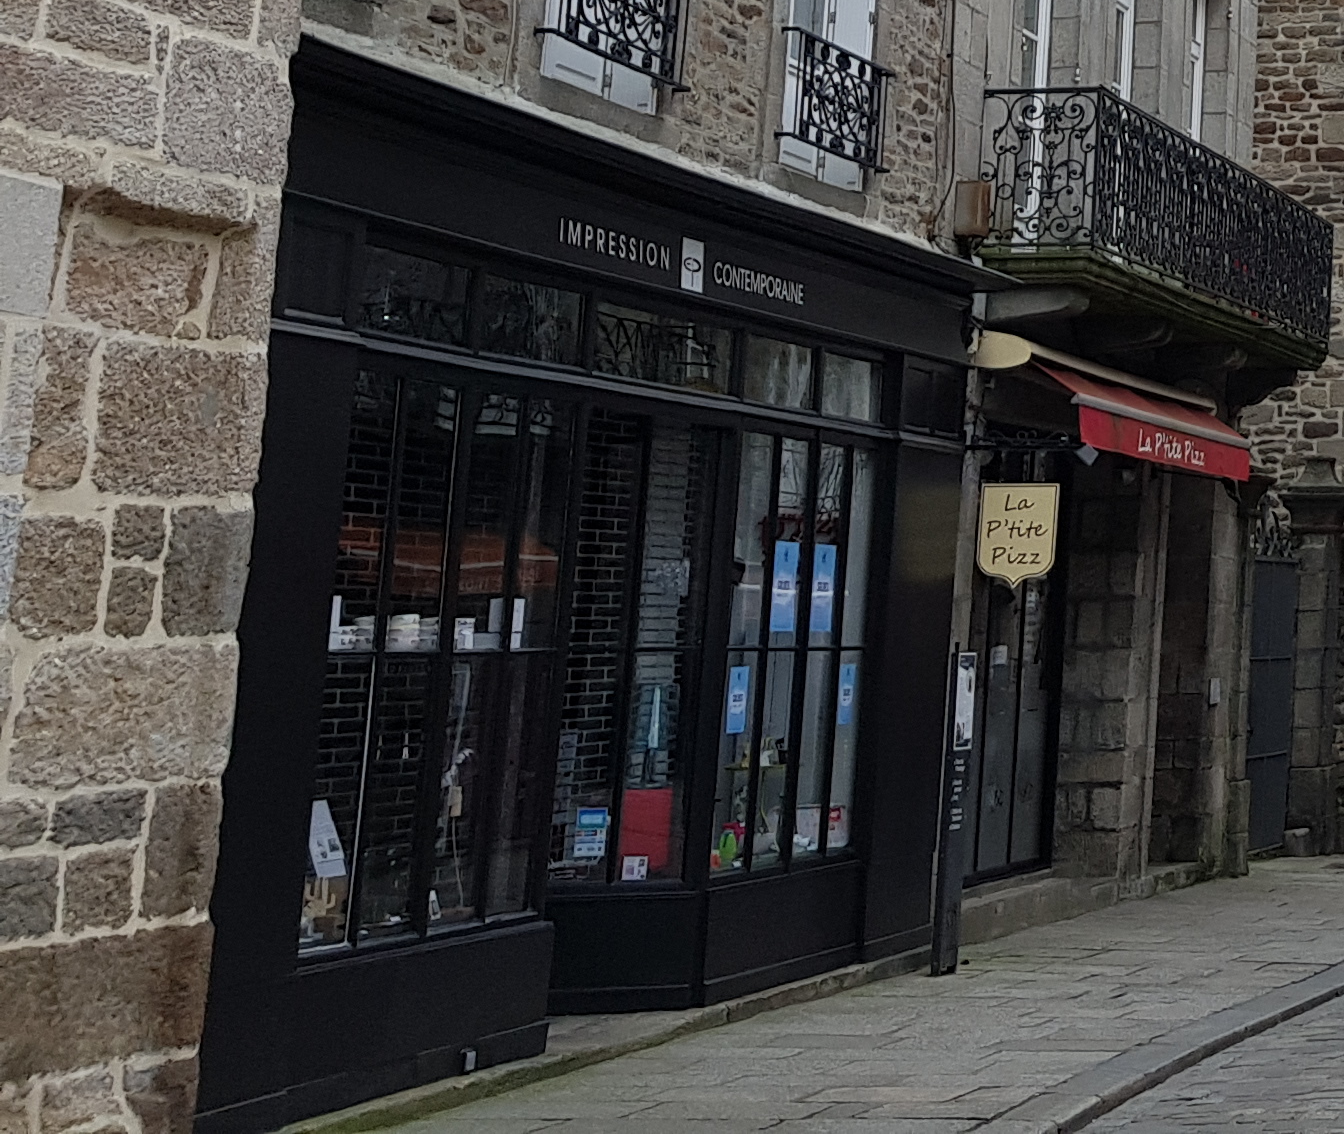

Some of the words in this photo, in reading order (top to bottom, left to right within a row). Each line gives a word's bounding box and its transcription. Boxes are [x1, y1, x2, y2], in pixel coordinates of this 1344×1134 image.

[559, 217, 670, 270] IMPRESSION
[713, 261, 804, 305] CONTEMPORAINE
[1138, 428, 1152, 452] La
[1155, 432, 1182, 459] P'tite
[1184, 440, 1205, 466] Pizz
[1004, 493, 1035, 512] La
[986, 518, 1049, 539] P'tite
[991, 546, 1041, 565] Pizz
